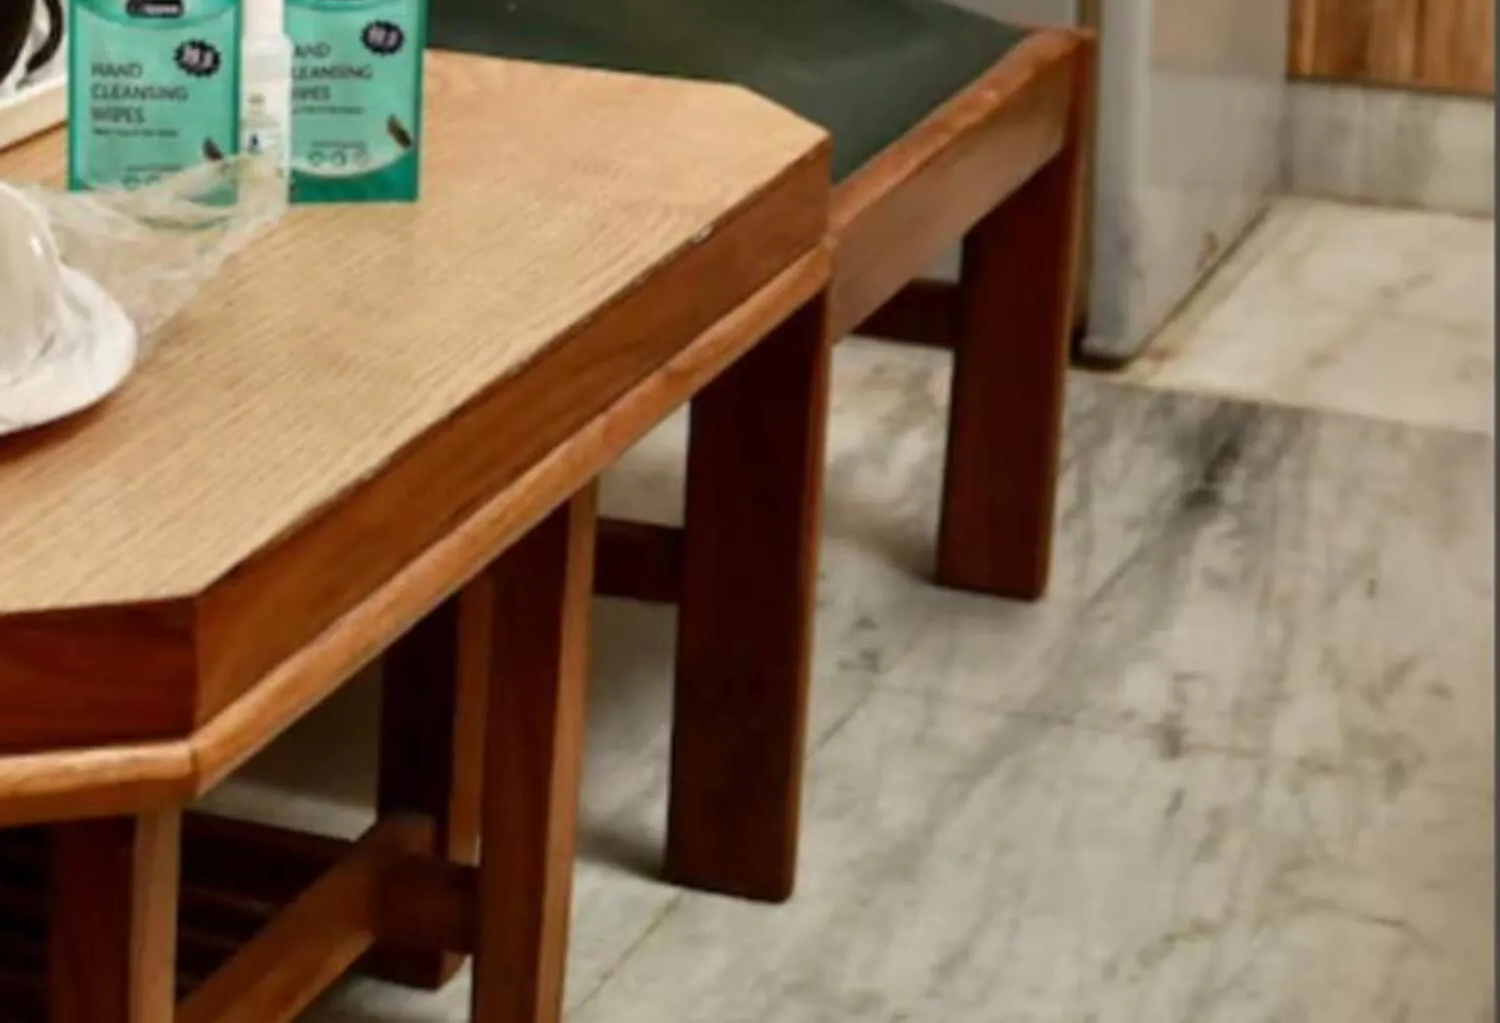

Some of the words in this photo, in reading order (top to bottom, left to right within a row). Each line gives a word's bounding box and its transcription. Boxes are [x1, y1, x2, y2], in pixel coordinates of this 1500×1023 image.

[293, 42, 331, 59] AND
[91, 63, 143, 78] HAND
[292, 64, 374, 80] LEANSING
[91, 83, 189, 102] CLEANSING
[91, 106, 146, 123] WIPES
